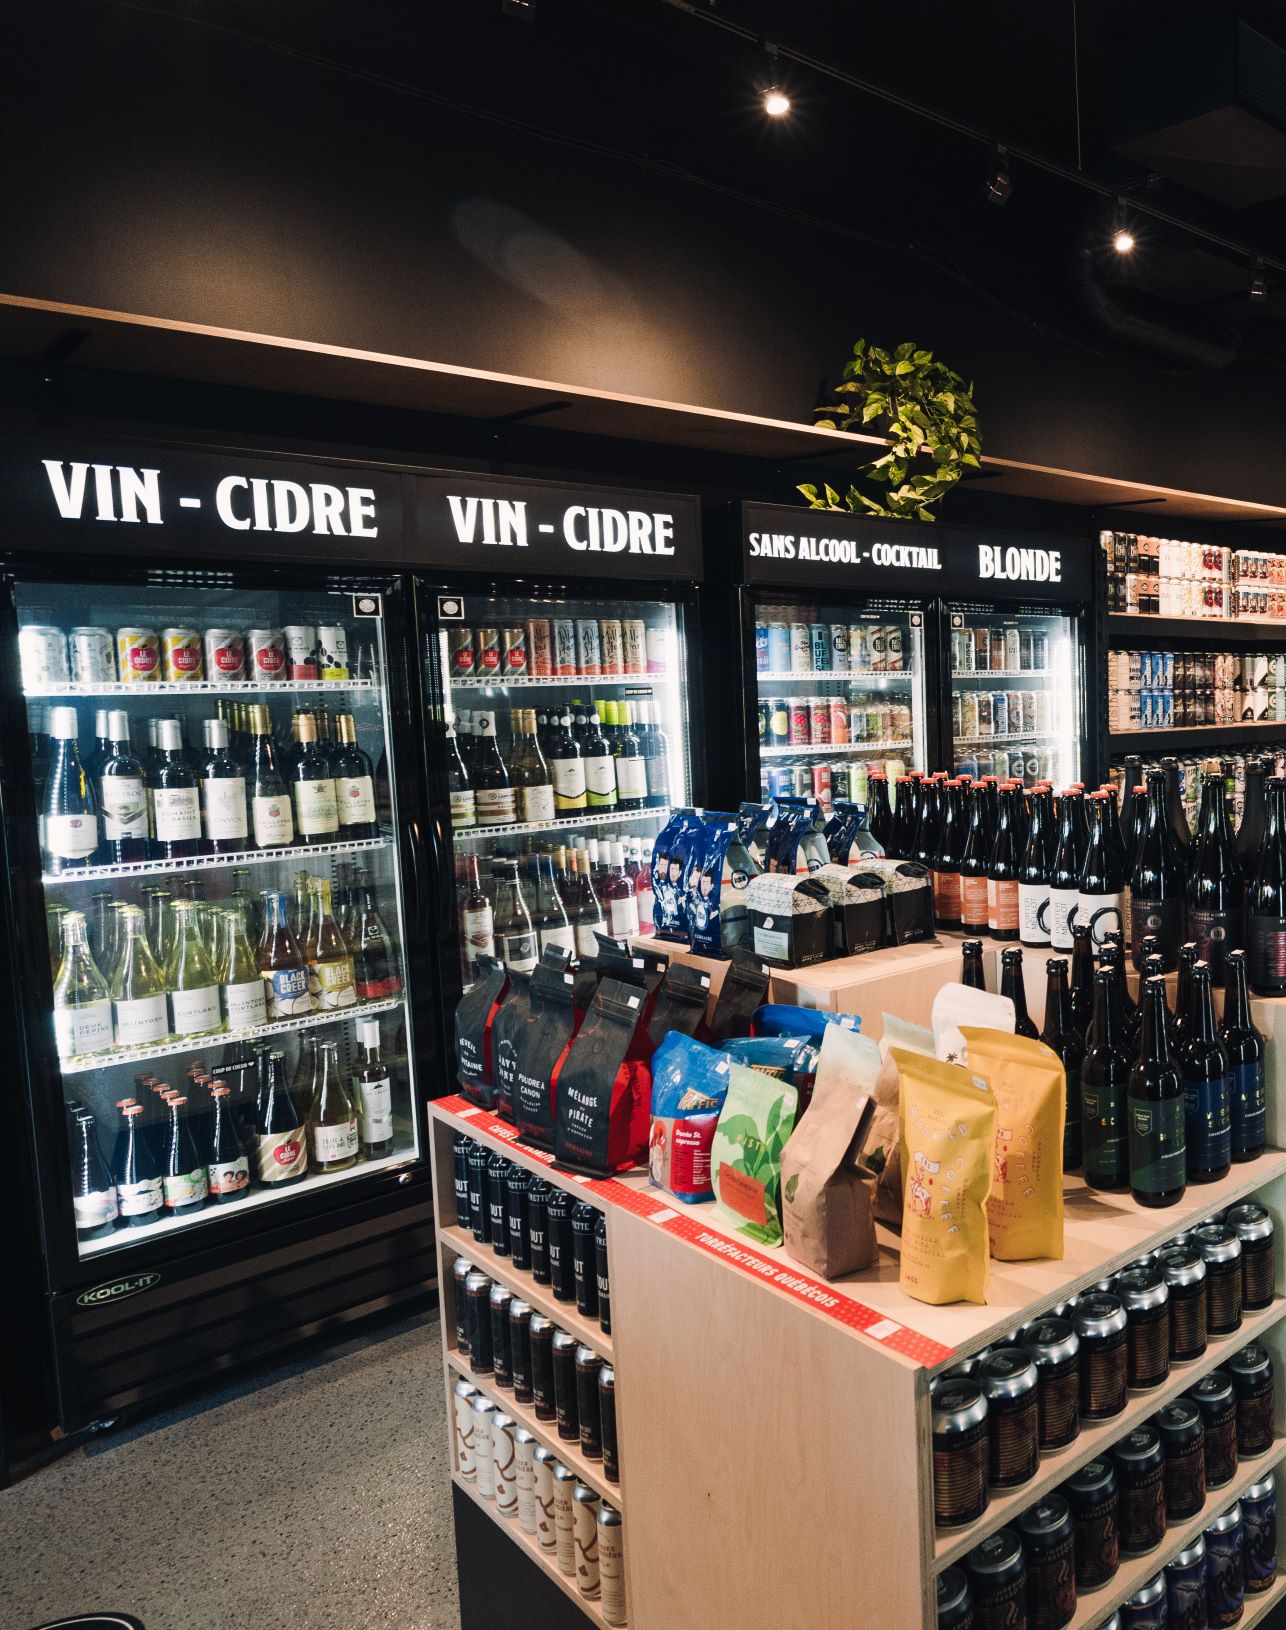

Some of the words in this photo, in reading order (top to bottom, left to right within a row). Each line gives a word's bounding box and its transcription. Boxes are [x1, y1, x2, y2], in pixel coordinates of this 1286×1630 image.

[42, 460, 163, 524] VIN
[216, 475, 378, 538] CIDRE
[447, 496, 529, 546] VIN
[563, 506, 675, 556] CIDRE
[749, 533, 795, 558] SANS
[798, 537, 860, 564] ALCOOL
[872, 543, 942, 570] COCKTAIL
[979, 545, 1062, 582] BLONDE
[279, 970, 305, 984] BLACK
[324, 964, 350, 977] BLACK
[280, 979, 306, 993] CREEK
[212, 1067, 224, 1075] COUP
[518, 1073, 540, 1089] POUDRE
[520, 1086, 541, 1099] CANON
[568, 1087, 598, 1107] MÉLANGE
[568, 1109, 594, 1128] PIRATE
[675, 1130, 693, 1139] Dante
[693, 1131, 702, 1139] St.
[675, 1138, 701, 1146] espresso
[695, 1232, 775, 1277] TORRÉFACTEURS
[774, 1272, 840, 1308] QUÉBÉCOIS
[84, 1275, 154, 1303] KOOL-IT
